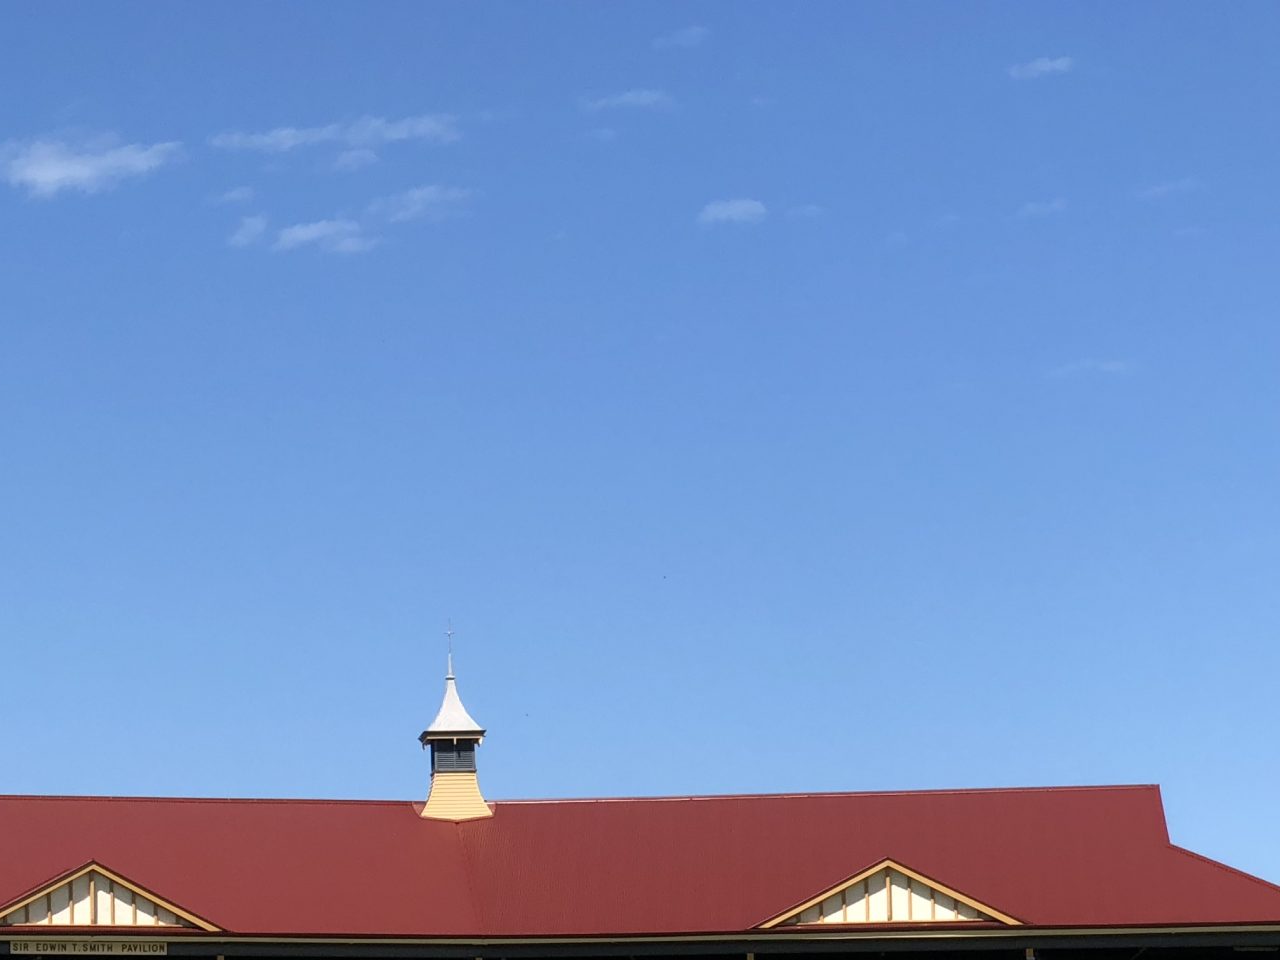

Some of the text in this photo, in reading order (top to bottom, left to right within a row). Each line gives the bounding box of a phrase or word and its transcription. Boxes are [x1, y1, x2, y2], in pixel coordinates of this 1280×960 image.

[13, 943, 29, 951] SIR
[36, 943, 67, 952] EDWIN
[121, 943, 165, 953] PAVILION
